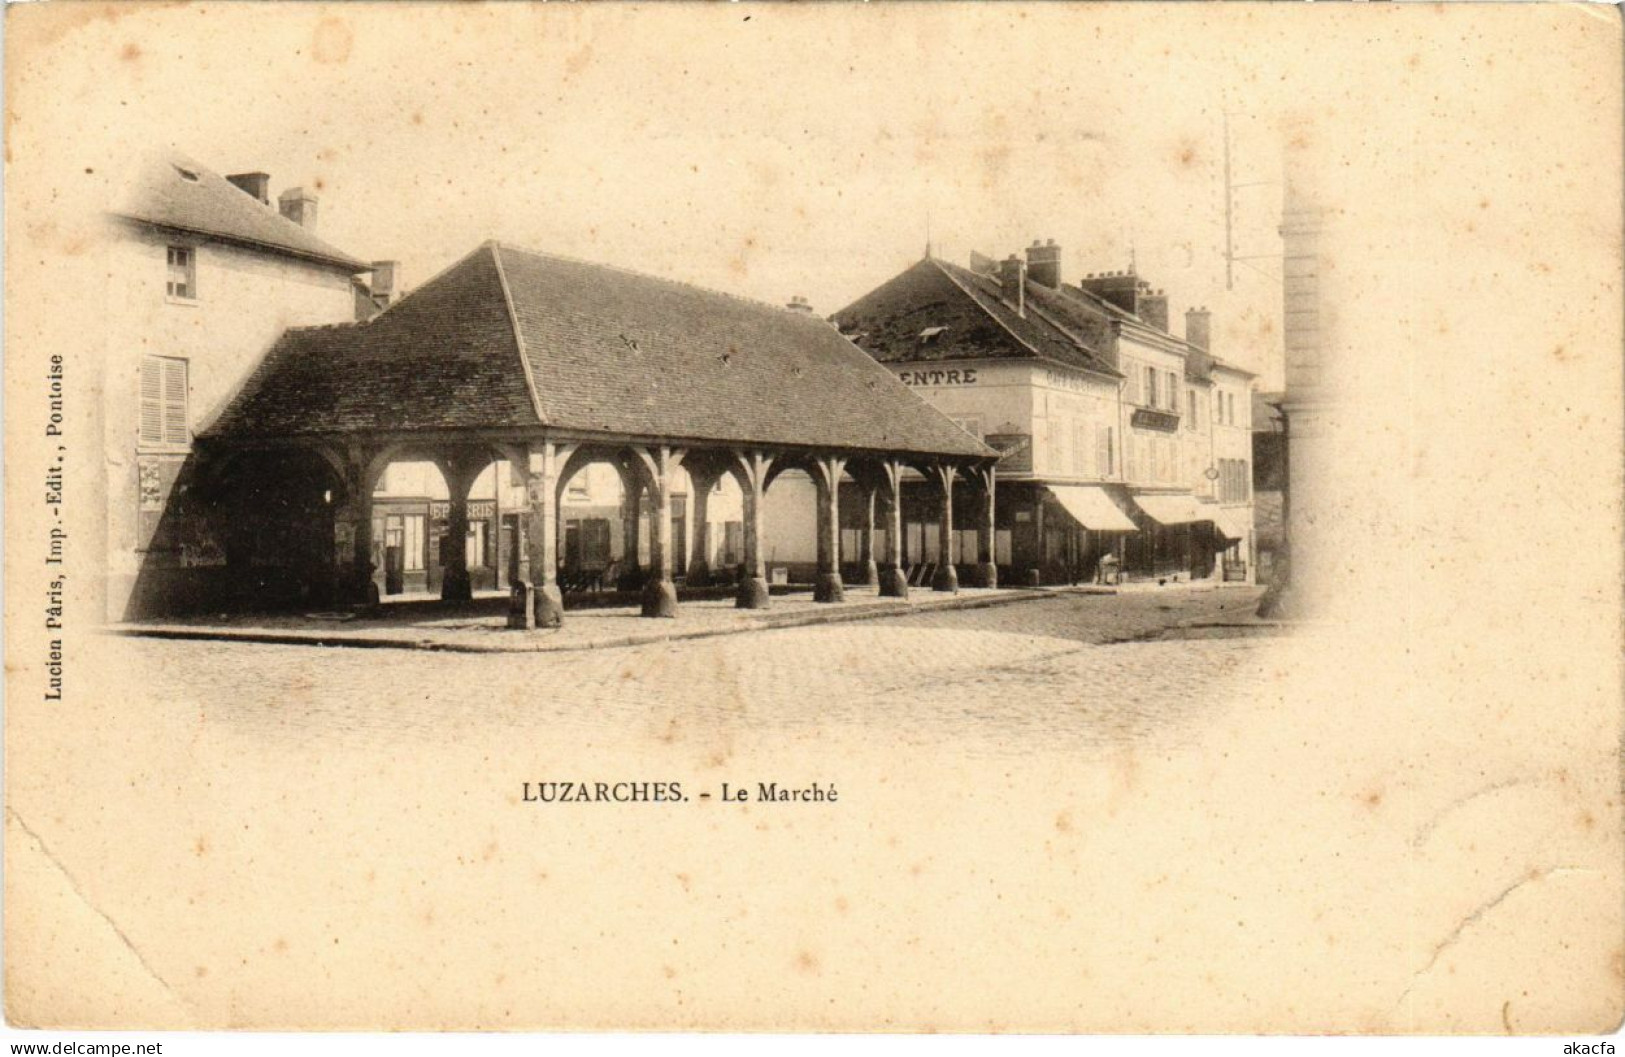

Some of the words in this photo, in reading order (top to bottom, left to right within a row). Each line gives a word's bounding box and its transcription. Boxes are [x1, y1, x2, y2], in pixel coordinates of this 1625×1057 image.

[45, 353, 64, 437] Pontoise
[900, 369, 977, 386] ENTRE
[432, 502, 493, 519] EPERIE
[45, 574, 66, 630] Pâris,
[45, 639, 63, 702] Lucien
[522, 782, 689, 802] LUZARCHES.
[721, 782, 749, 802] Le
[758, 782, 839, 802] Marché
